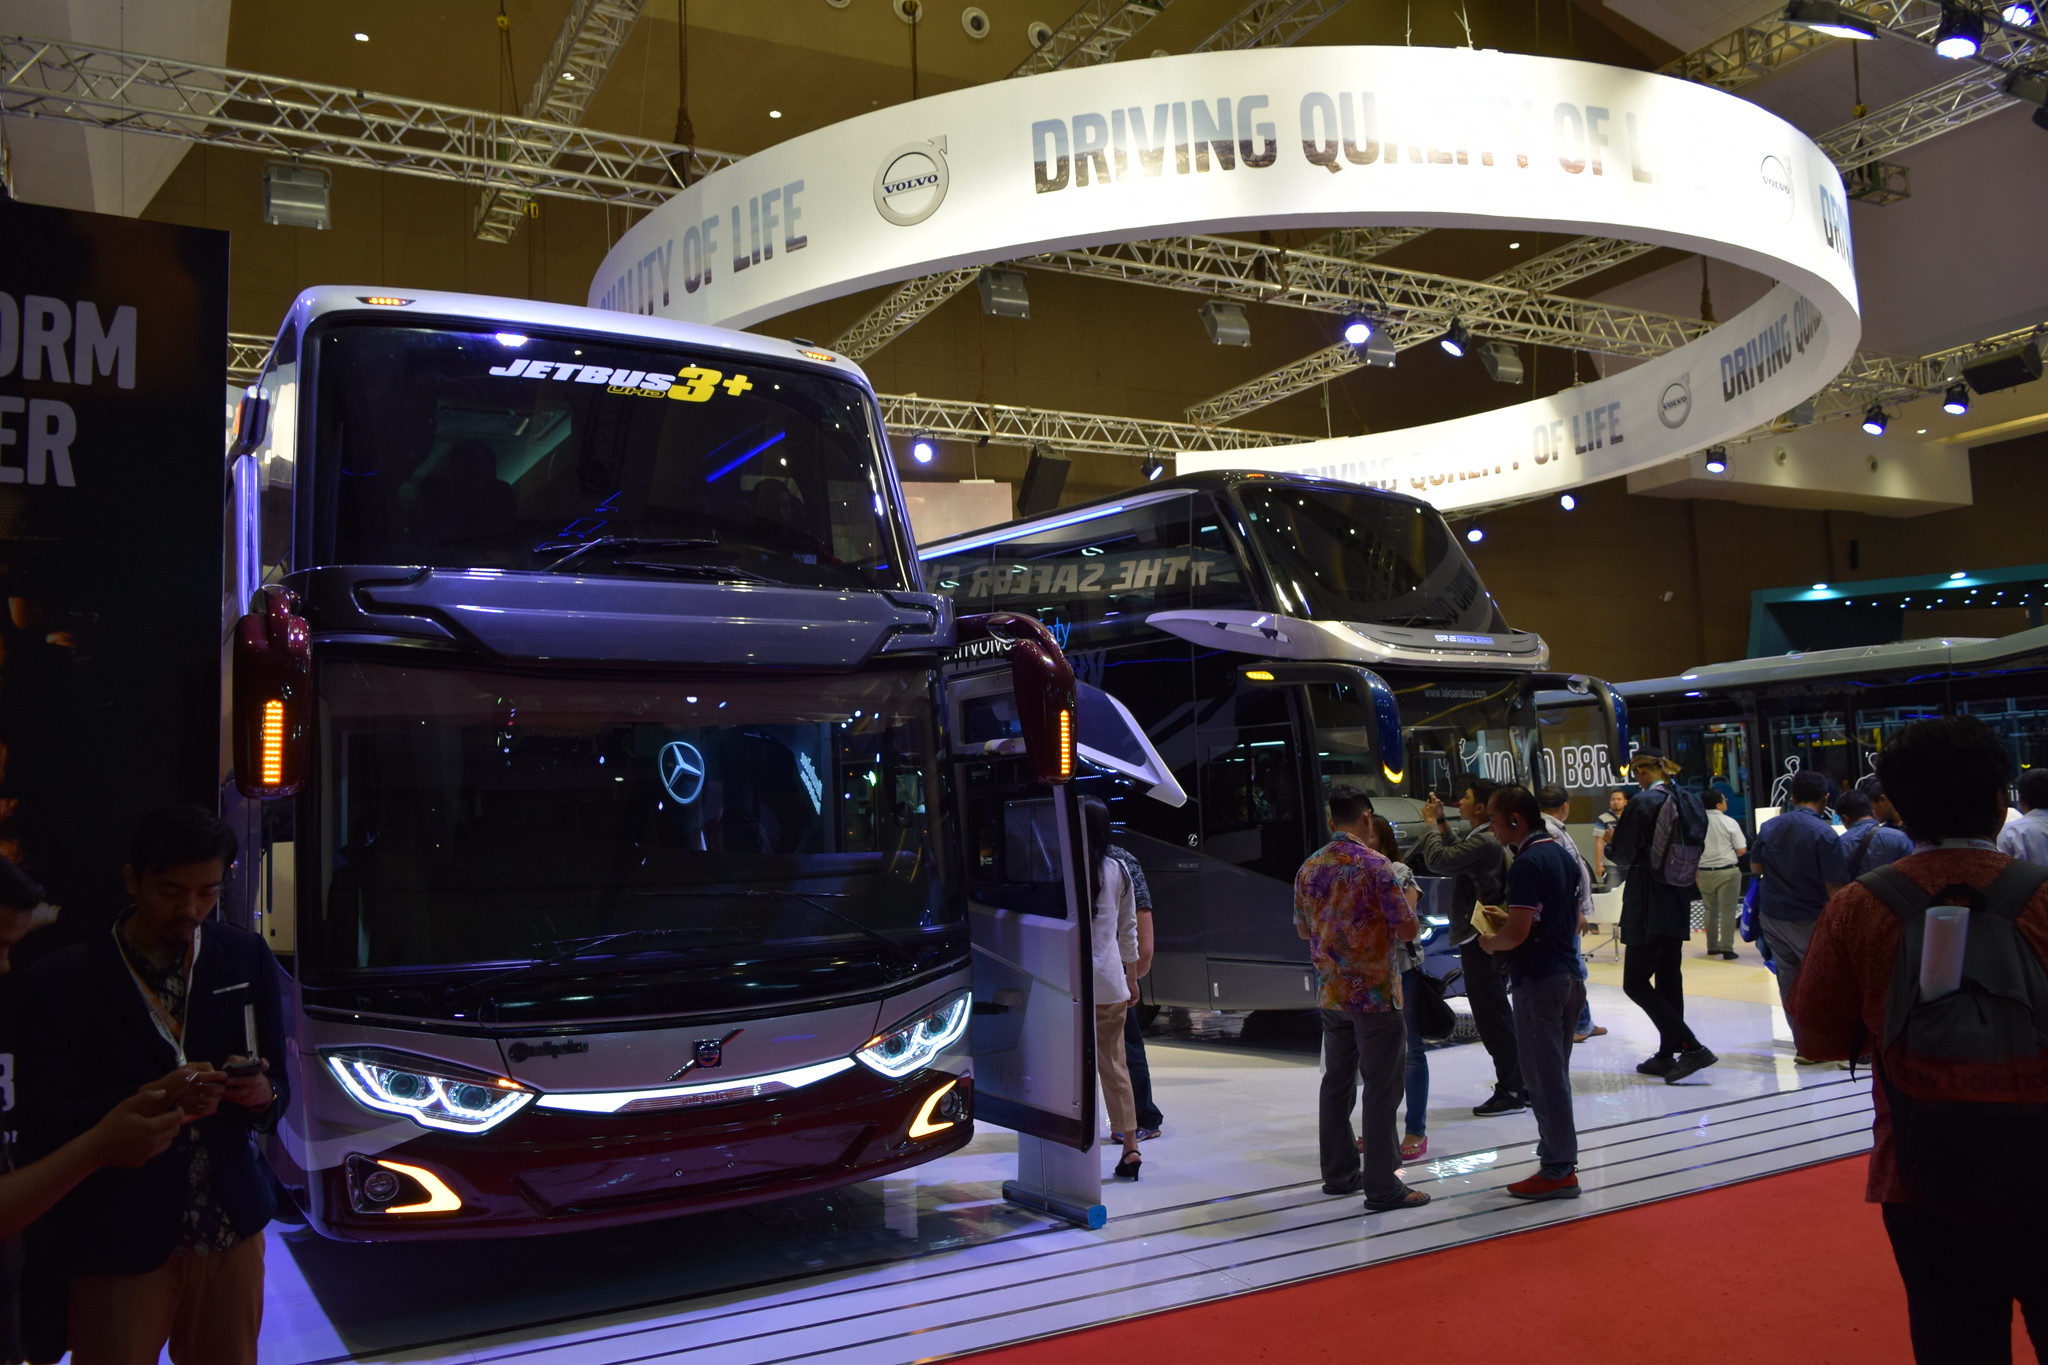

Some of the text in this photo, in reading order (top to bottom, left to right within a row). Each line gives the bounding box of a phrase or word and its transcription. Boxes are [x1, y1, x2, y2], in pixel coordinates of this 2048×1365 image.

[1031, 93, 1278, 194] DRIVING
[1553, 102, 1610, 177] OF
[883, 174, 938, 194] VOLVO
[1762, 176, 1791, 194] VOLVO
[600, 179, 807, 316] ALITY OF LIFE
[1720, 312, 1792, 402] DRIVING
[606, 385, 667, 399] UHD
[1662, 396, 1688, 411] VOLVO
[1533, 401, 1624, 465] OF LIFE
